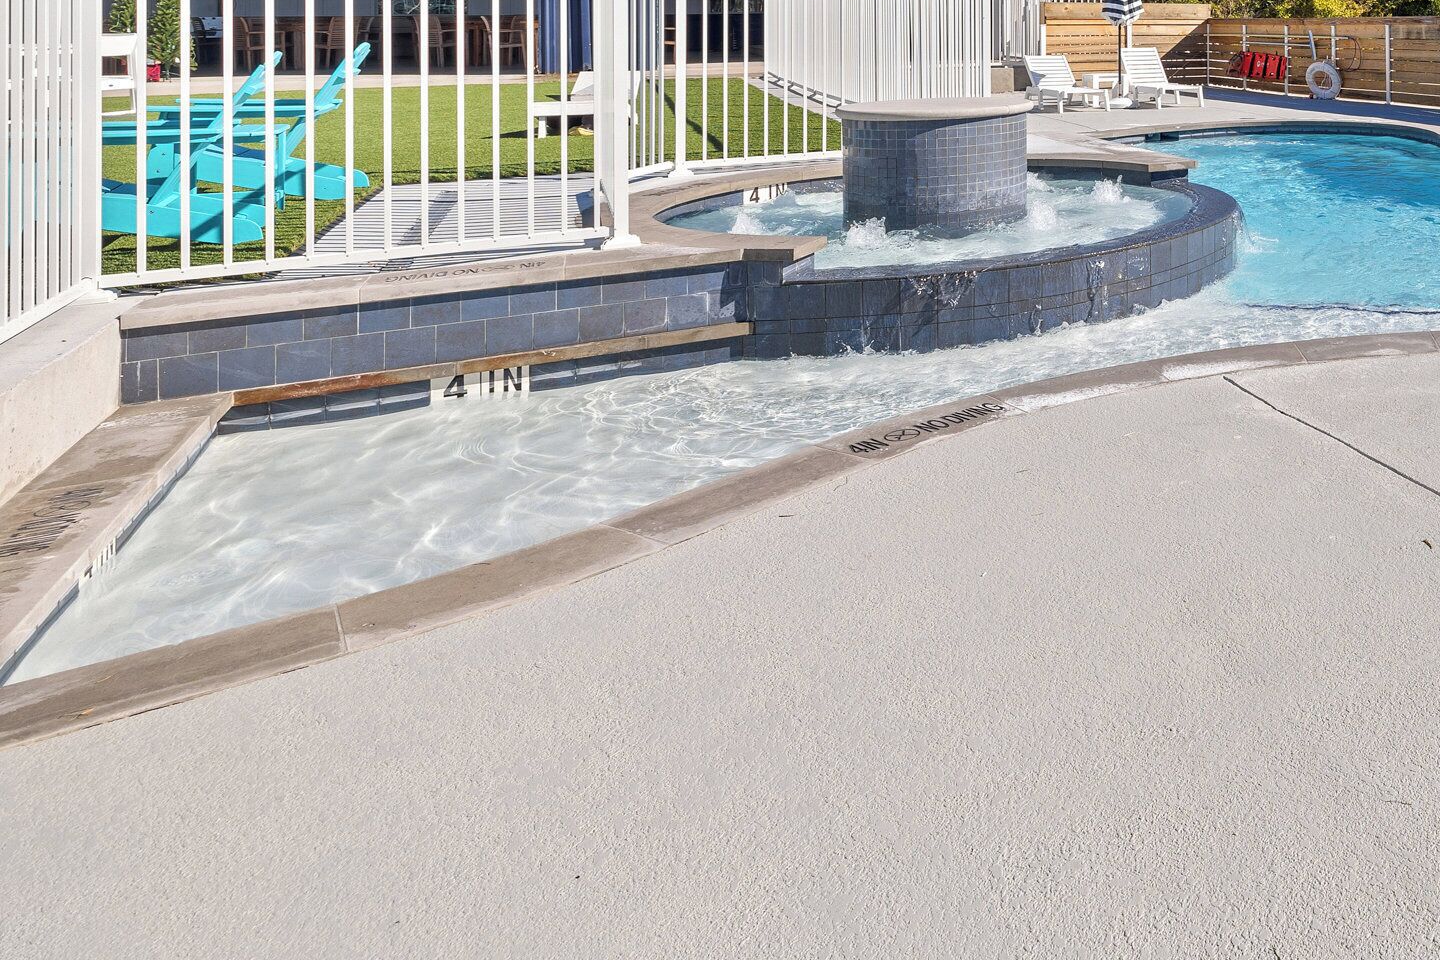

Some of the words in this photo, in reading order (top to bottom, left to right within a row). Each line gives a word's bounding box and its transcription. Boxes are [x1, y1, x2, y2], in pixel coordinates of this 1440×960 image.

[749, 186, 760, 203] 4
[769, 182, 786, 200] IN
[443, 373, 468, 398] 4
[489, 366, 522, 393] IN
[914, 419, 950, 433] NO
[945, 402, 1004, 424] DIVING
